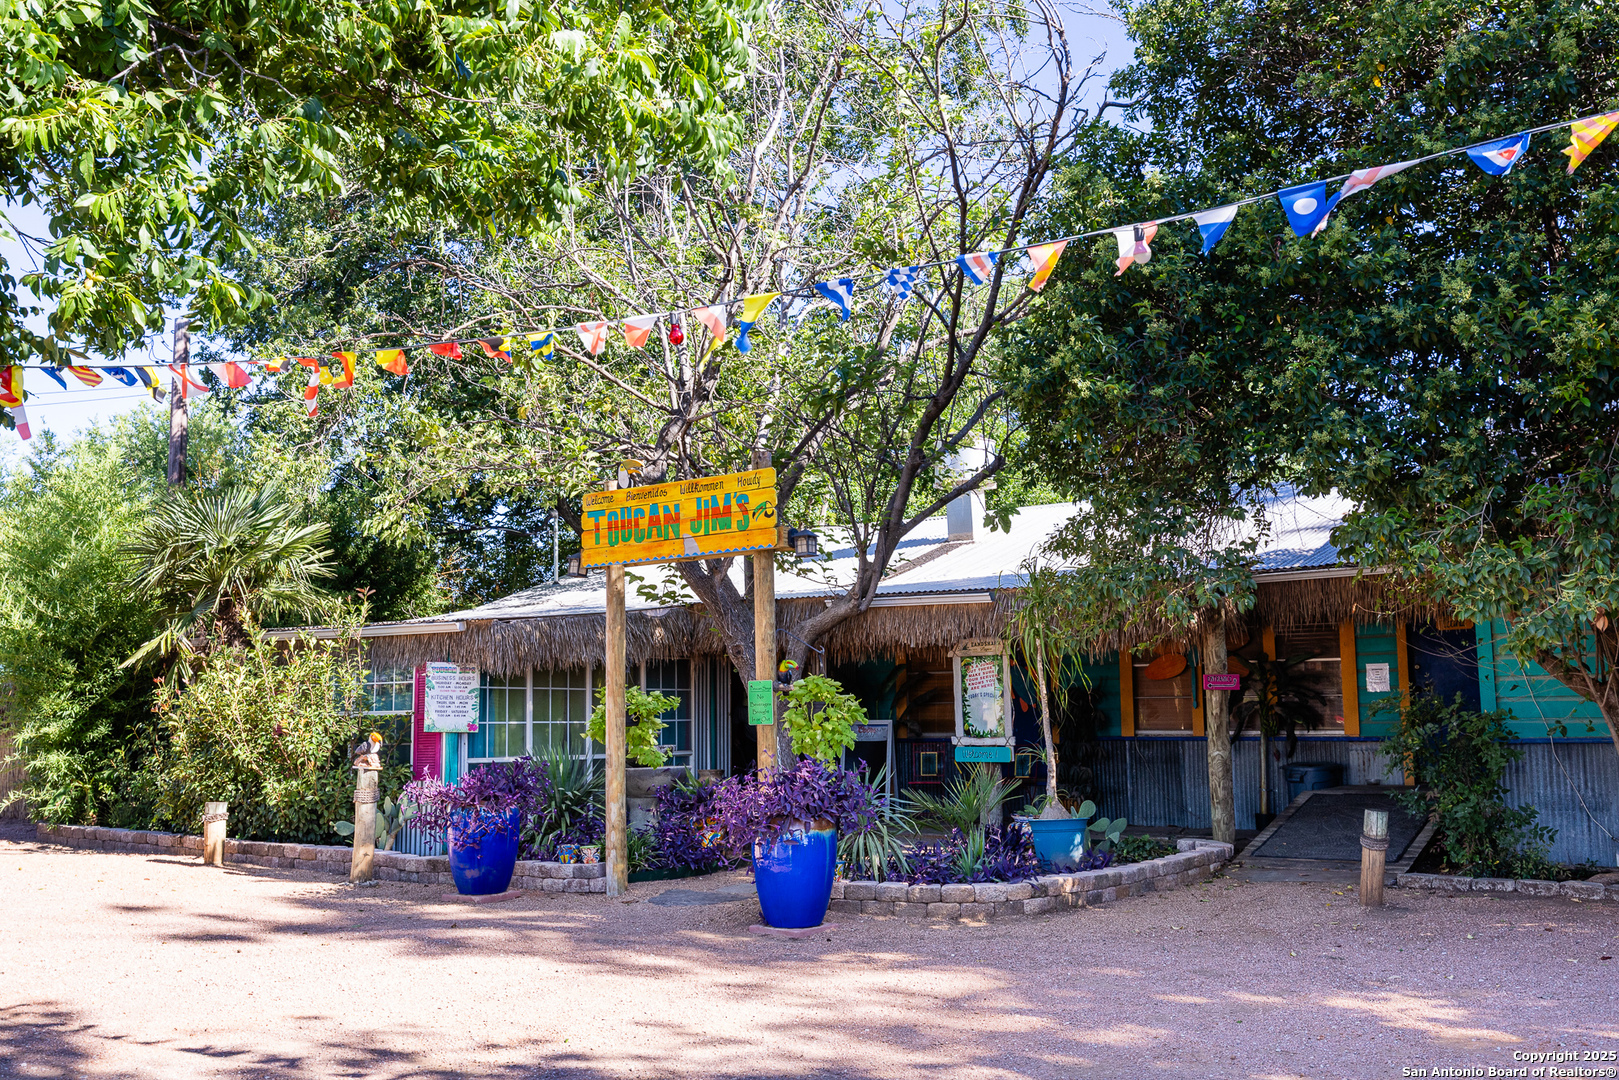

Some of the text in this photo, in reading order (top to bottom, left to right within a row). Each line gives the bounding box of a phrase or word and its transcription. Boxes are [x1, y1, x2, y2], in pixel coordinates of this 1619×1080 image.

[586, 472, 761, 506] Welcome Bienvenidos Willkommen Howdy
[587, 492, 750, 547] TOUCAN JIM'S
